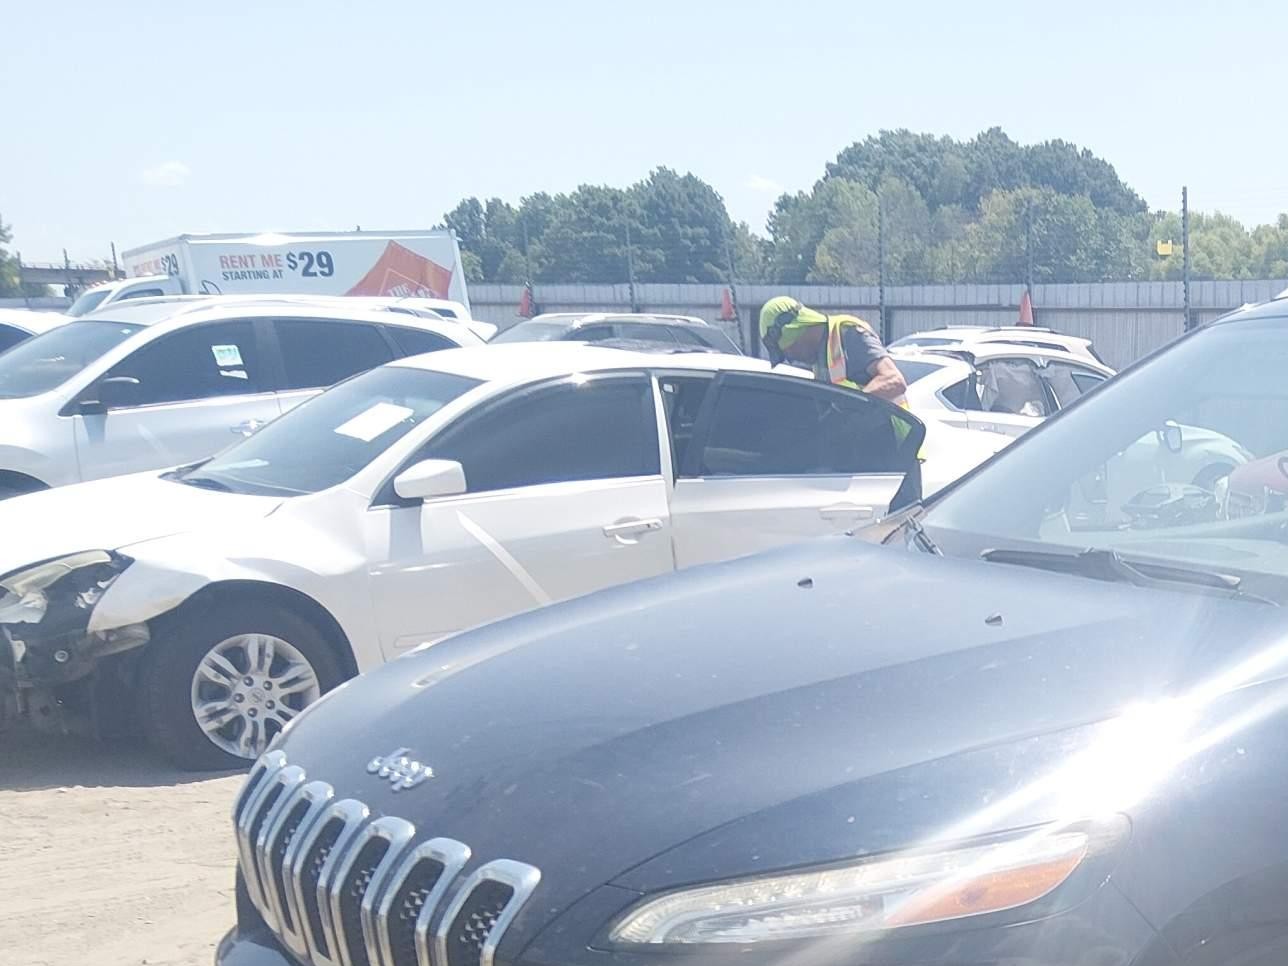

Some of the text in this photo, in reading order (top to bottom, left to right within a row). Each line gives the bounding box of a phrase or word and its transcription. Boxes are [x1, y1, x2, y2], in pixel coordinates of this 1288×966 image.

[218, 253, 284, 269] RENT ME
[286, 251, 335, 278] $29
[222, 269, 284, 281] STARTING AT
